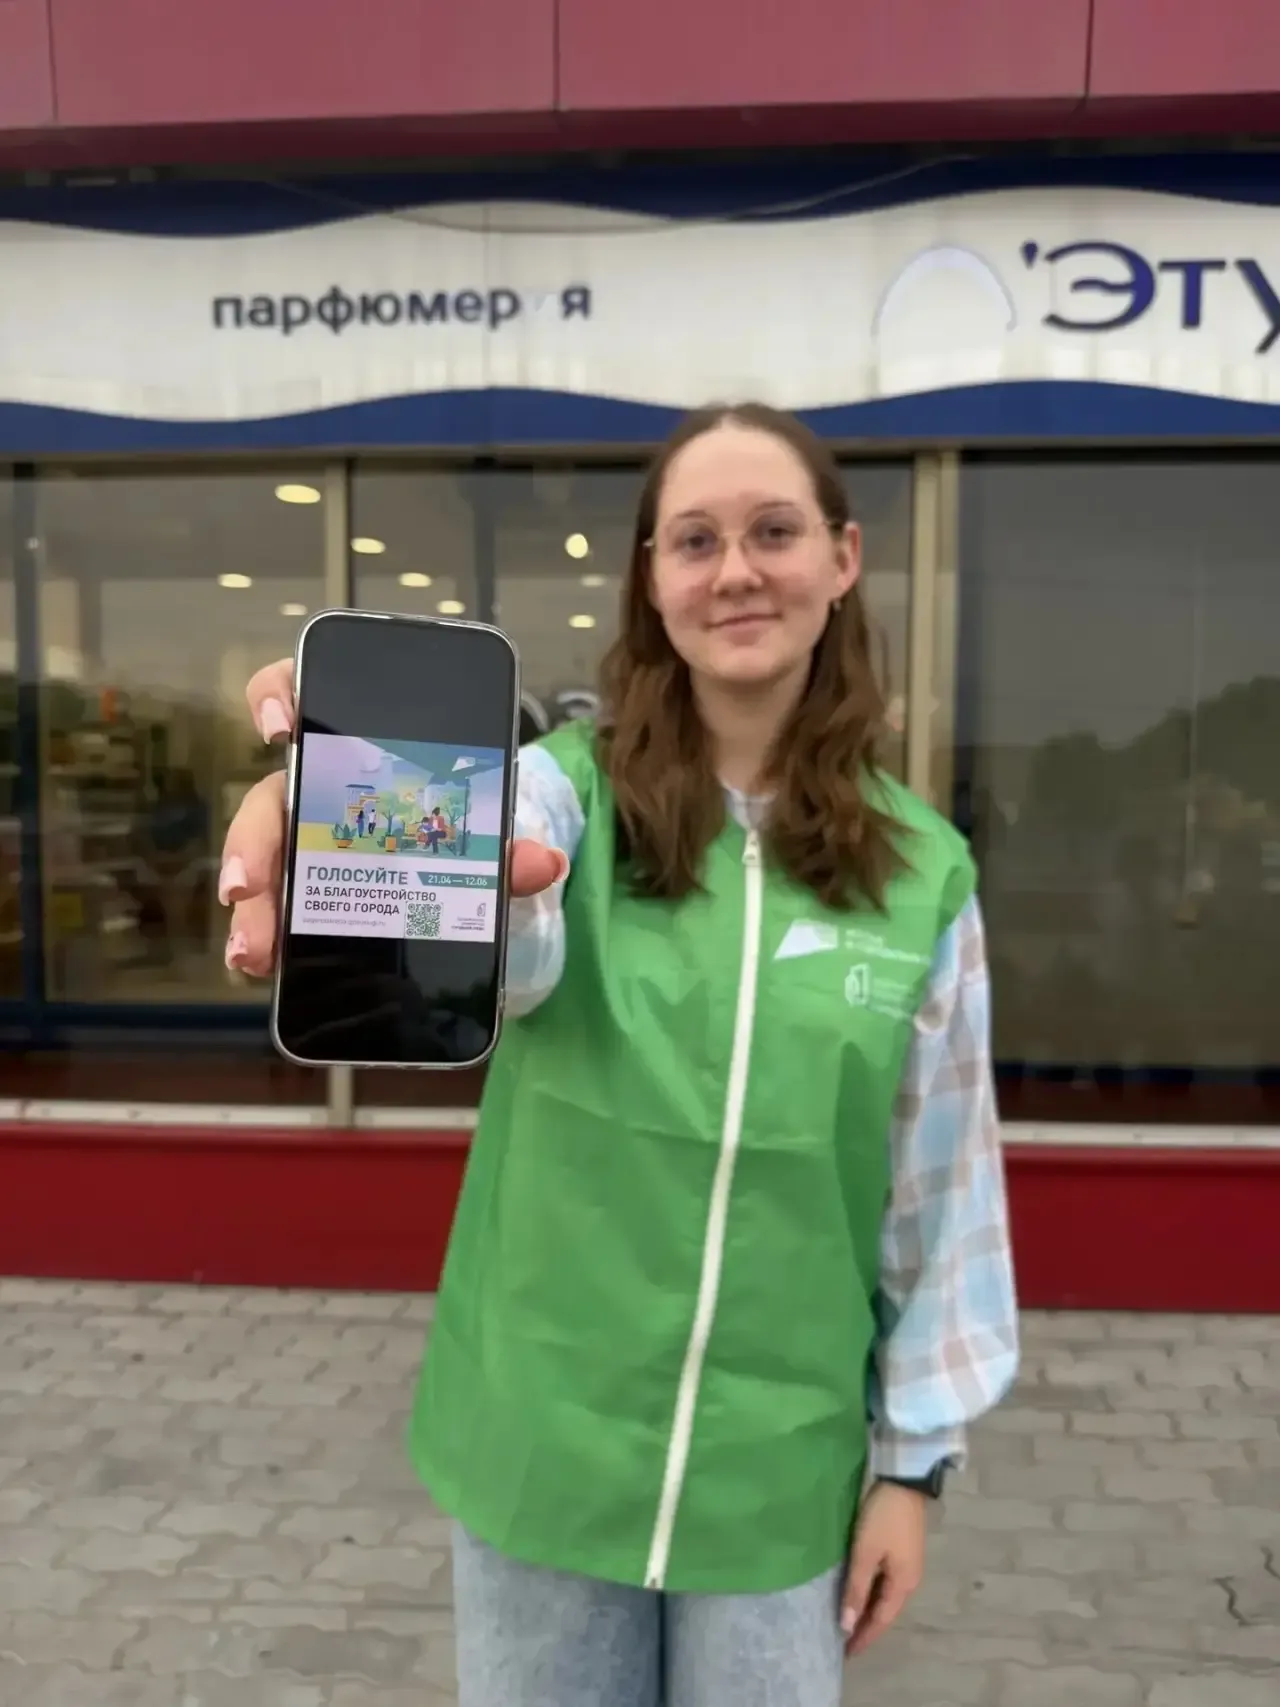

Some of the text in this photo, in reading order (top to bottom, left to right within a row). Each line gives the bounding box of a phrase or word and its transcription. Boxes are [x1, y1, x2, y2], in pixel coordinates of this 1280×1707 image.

[211, 283, 591, 335] парфюмеря
[307, 866, 408, 885] ГОЛОСУЙТЕ
[427, 874, 451, 885] 21.04
[465, 876, 487, 886] 12.06
[305, 885, 436, 902] ЗА БЛАГОУСТРОЙСТВО
[304, 900, 399, 916] СВОЕГО ГОРОДА
